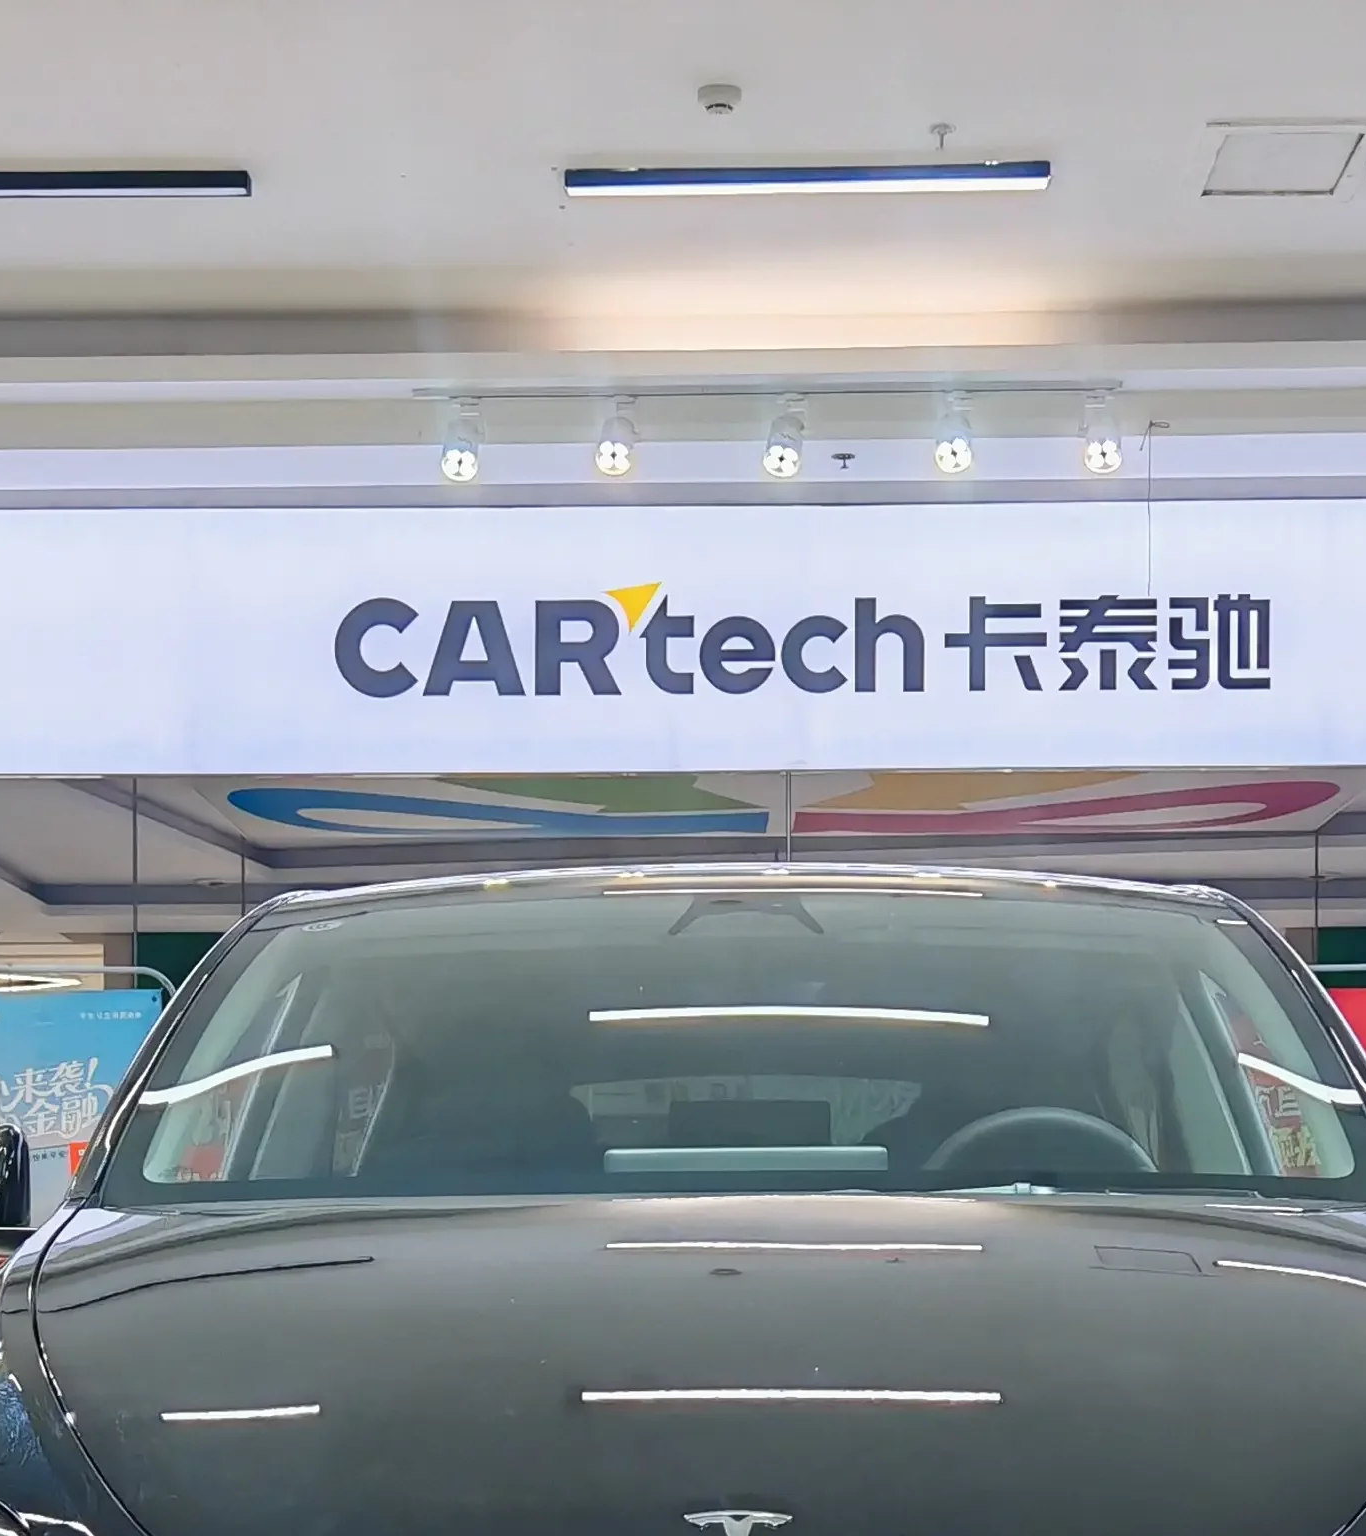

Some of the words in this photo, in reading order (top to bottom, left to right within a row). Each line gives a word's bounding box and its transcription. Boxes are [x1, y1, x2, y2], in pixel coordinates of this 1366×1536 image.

[334, 594, 925, 699] CARtech
[943, 594, 1272, 694] 卡泰驰
